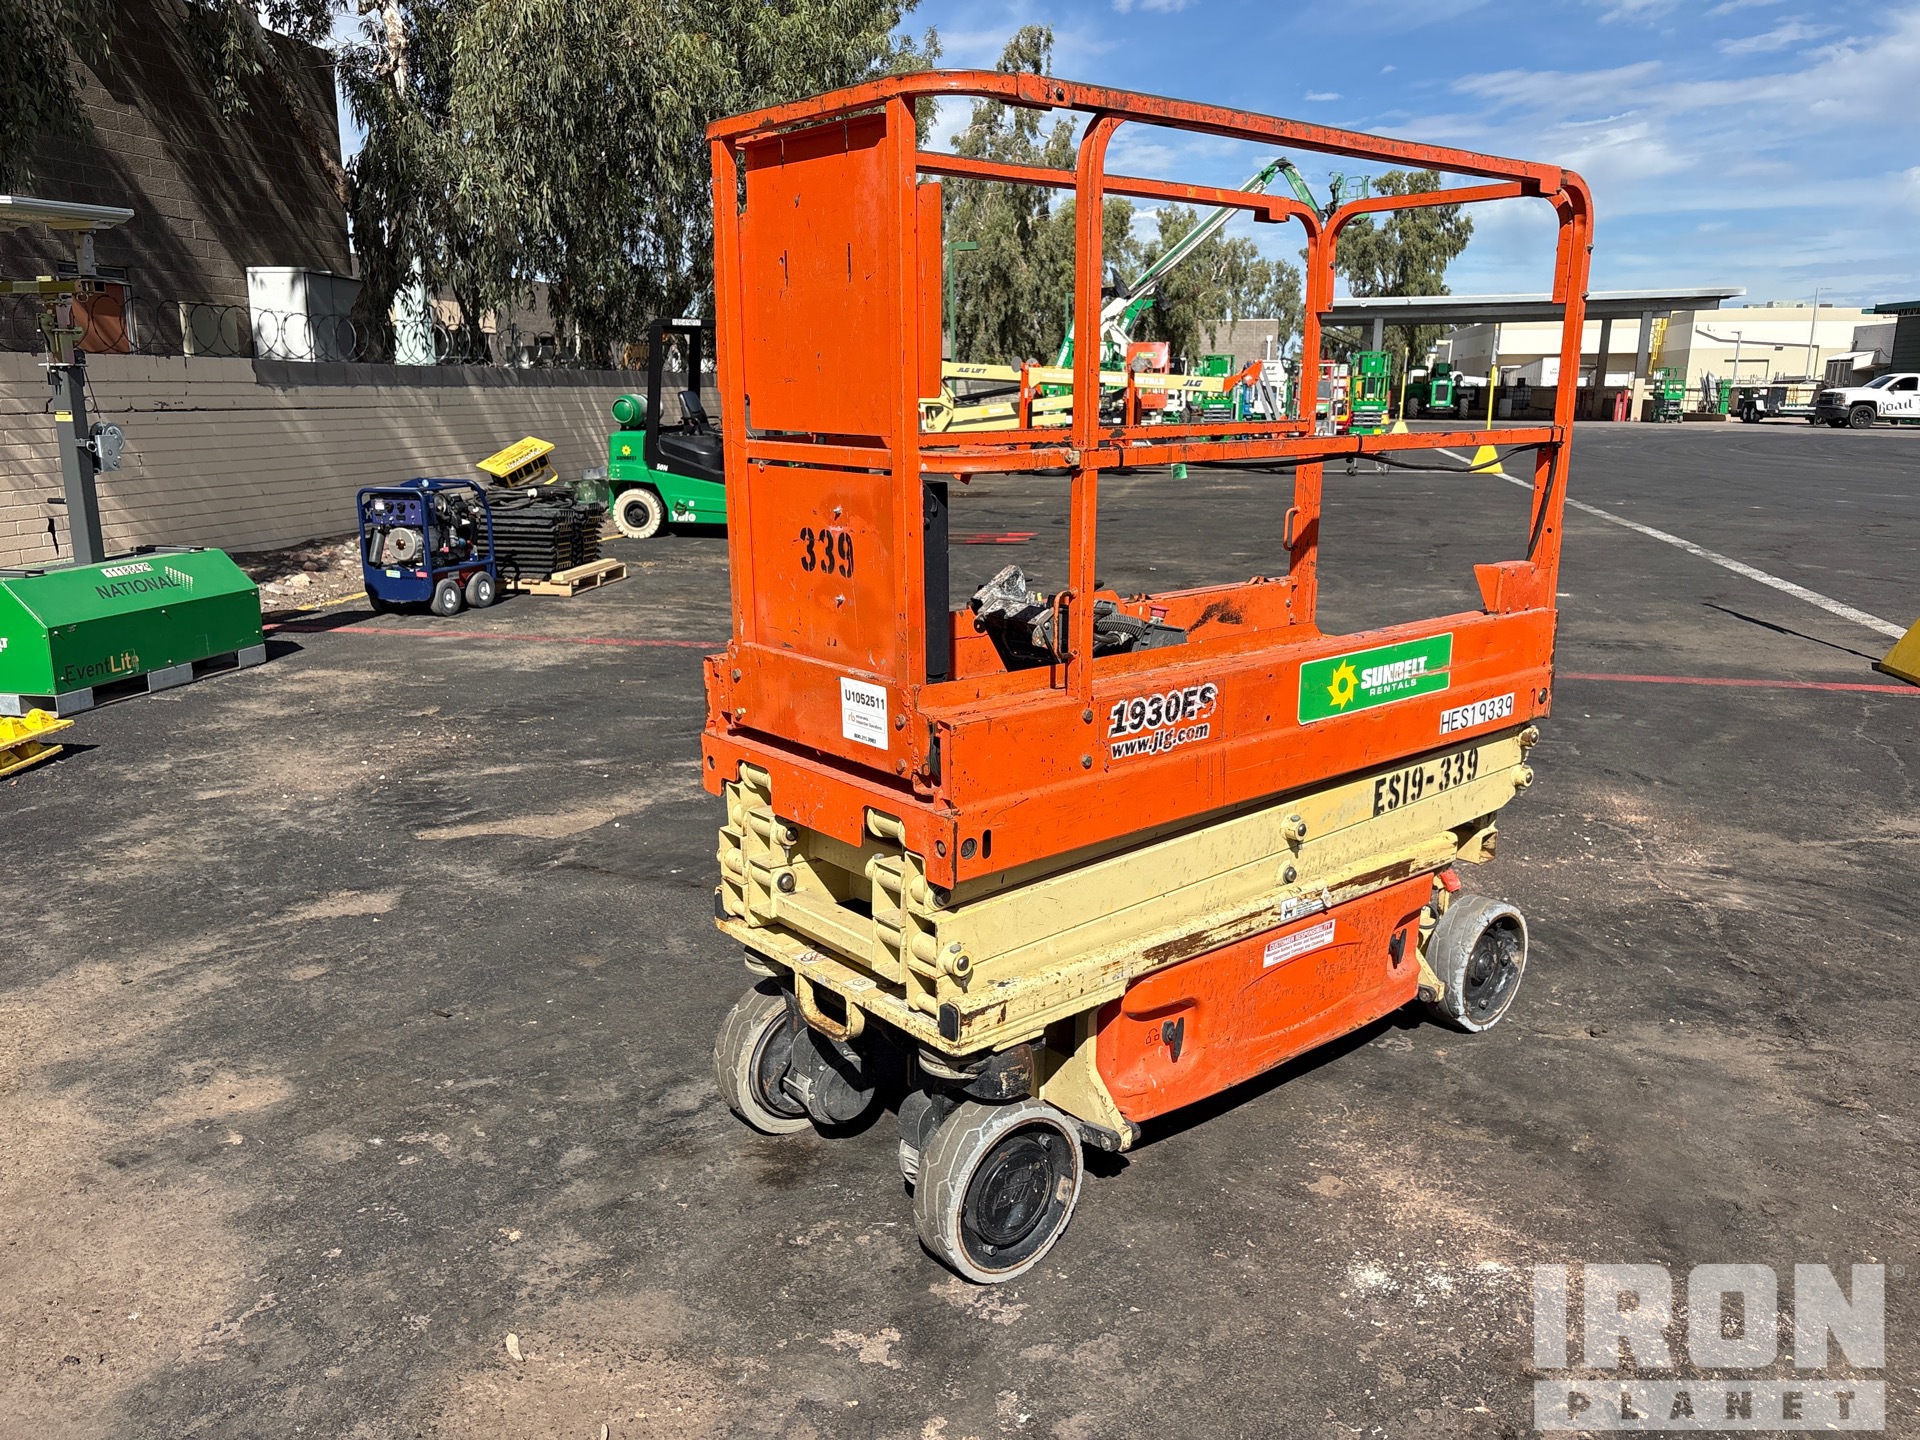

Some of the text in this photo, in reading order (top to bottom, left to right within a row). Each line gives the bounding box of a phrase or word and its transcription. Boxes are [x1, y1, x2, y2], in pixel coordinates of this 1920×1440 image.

[1183, 379, 1203, 387] JLG
[671, 510, 697, 522] Yale
[800, 527, 854, 578] 339
[95, 575, 181, 600] NATIONAL
[1361, 656, 1428, 689] SUNBELT
[1369, 678, 1417, 697] RENTALS
[845, 689, 885, 710] U1052511
[1108, 684, 1217, 737] 1930ES
[1440, 695, 1513, 734] HES19339
[1111, 722, 1210, 759] www.jlg.com
[1373, 748, 1479, 818] ES19-339
